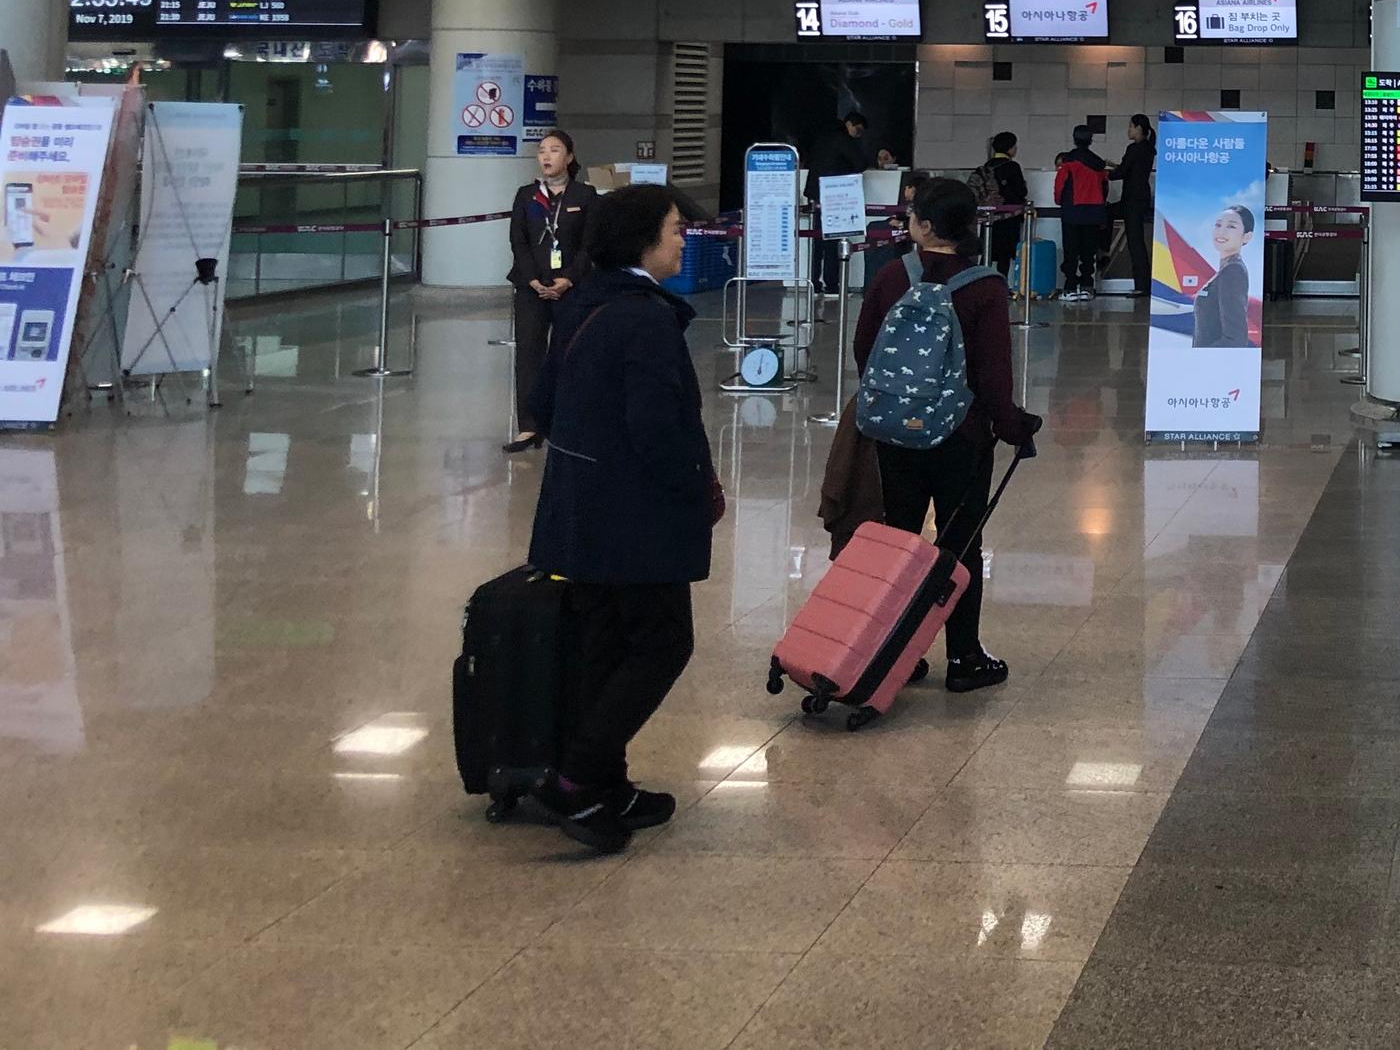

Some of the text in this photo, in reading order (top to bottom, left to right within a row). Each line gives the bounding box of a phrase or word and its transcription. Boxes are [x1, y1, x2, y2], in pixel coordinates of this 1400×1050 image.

[75, 14, 97, 24] Nov
[109, 14, 133, 25] 2019
[796, 8, 820, 31] 14
[985, 9, 1008, 32] 15
[1021, 10, 1088, 22] 아시아나항공
[1241, 12, 1268, 22] 부치는
[1271, 12, 1280, 22] 곳
[830, 18, 914, 29] Diamond Gold
[1175, 11, 1197, 34] 16
[1228, 24, 1290, 34] Bag Drop Only
[1165, 137, 1245, 150] 아름다운 사람들
[1165, 152, 1231, 164] 아시아나항공
[1167, 397, 1231, 409] 아시아나항공
[1164, 432, 1231, 440] STAR ALLIANCE
